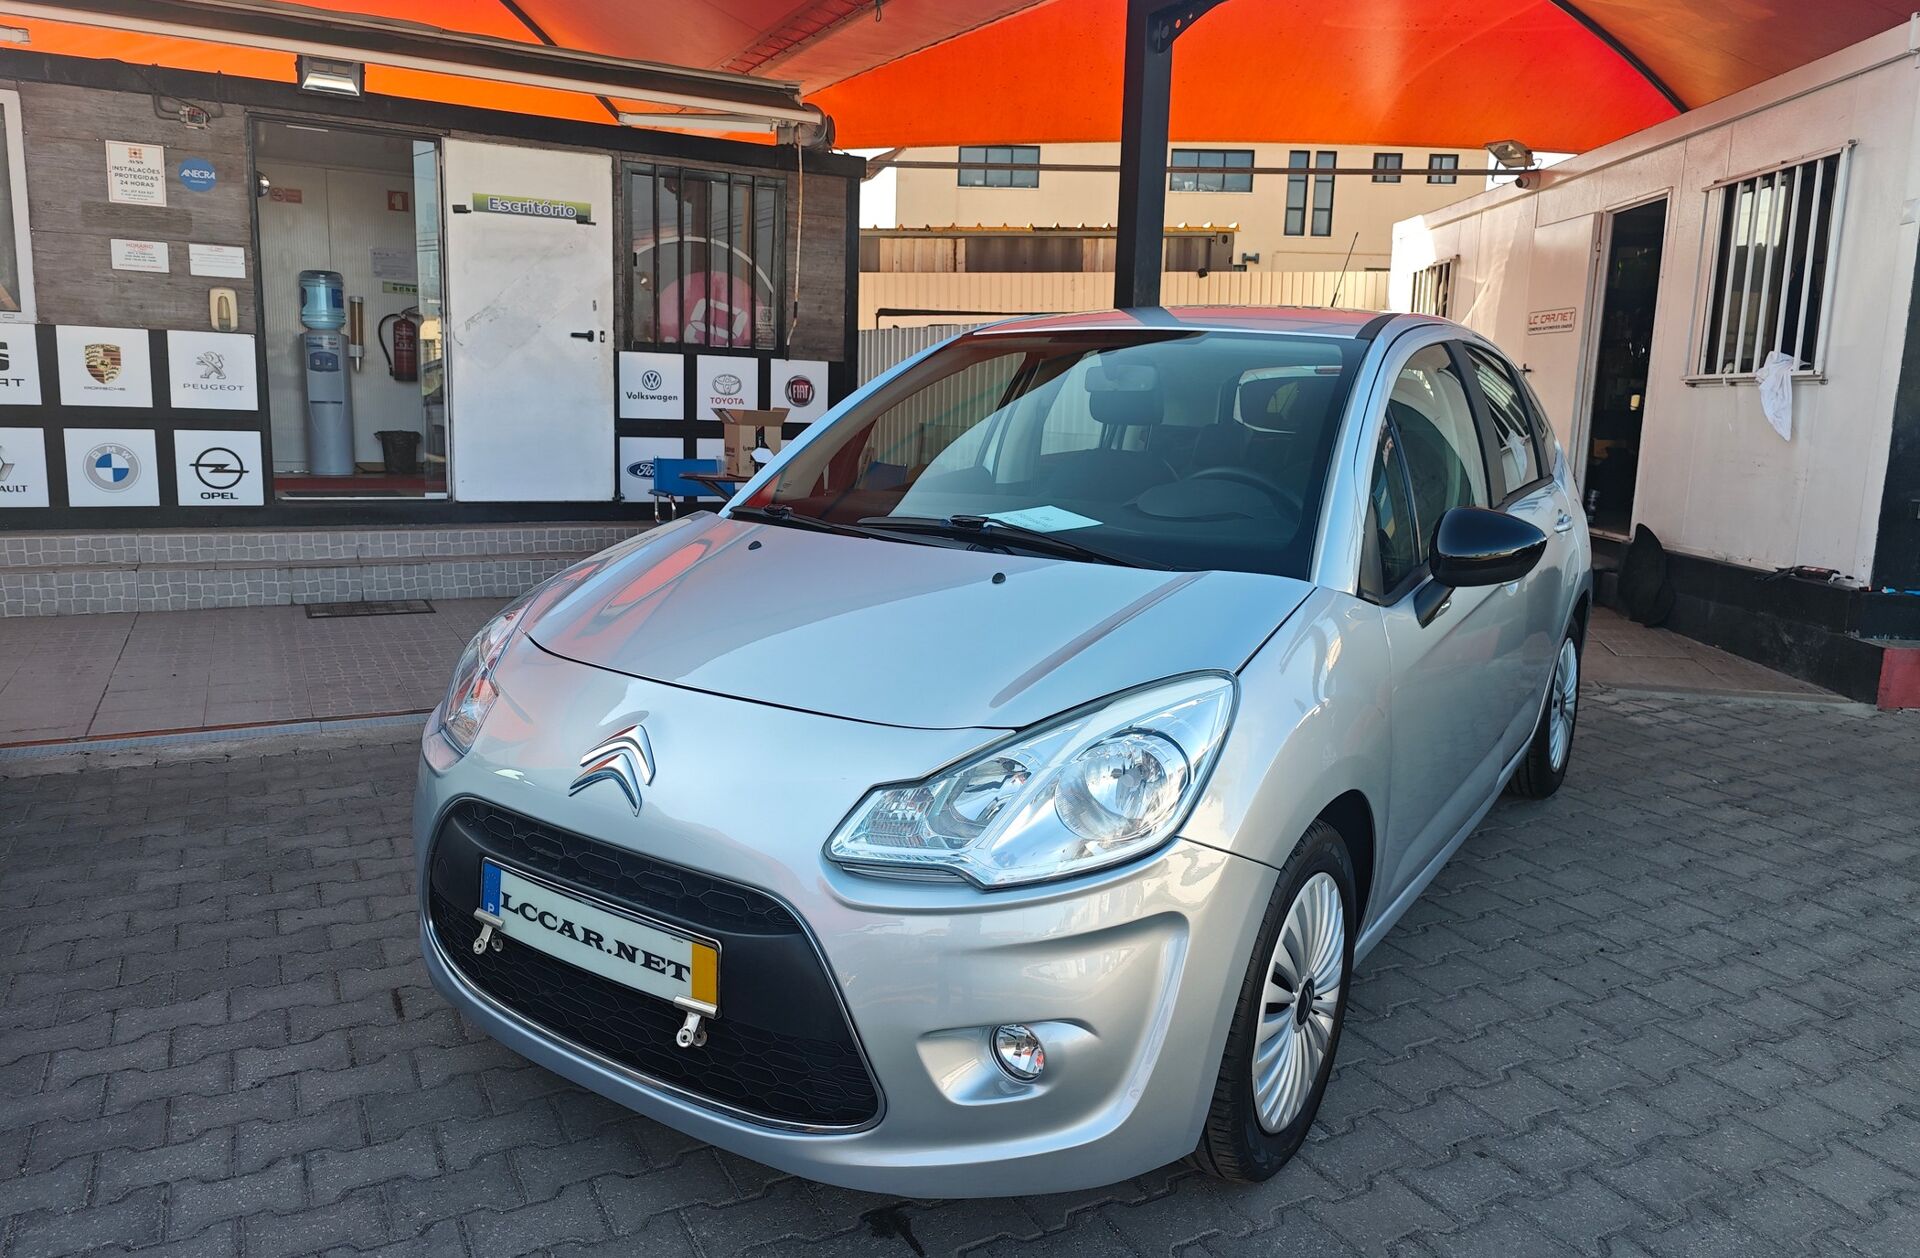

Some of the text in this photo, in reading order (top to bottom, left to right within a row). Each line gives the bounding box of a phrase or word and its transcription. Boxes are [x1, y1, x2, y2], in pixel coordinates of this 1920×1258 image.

[112, 165, 161, 175] INSTALAÇÕES
[181, 169, 216, 179] ANECRA
[114, 173, 159, 181] PROTEGIDAS
[488, 196, 577, 217] Escritório
[183, 383, 244, 391] PEUGEOT
[792, 384, 809, 399] FIAT
[626, 391, 678, 402] Volkswagen
[710, 397, 744, 405] TOYOTA
[91, 446, 132, 460] BMW
[200, 492, 239, 500] OPEL
[487, 892, 691, 982] P LCCAR.NET
